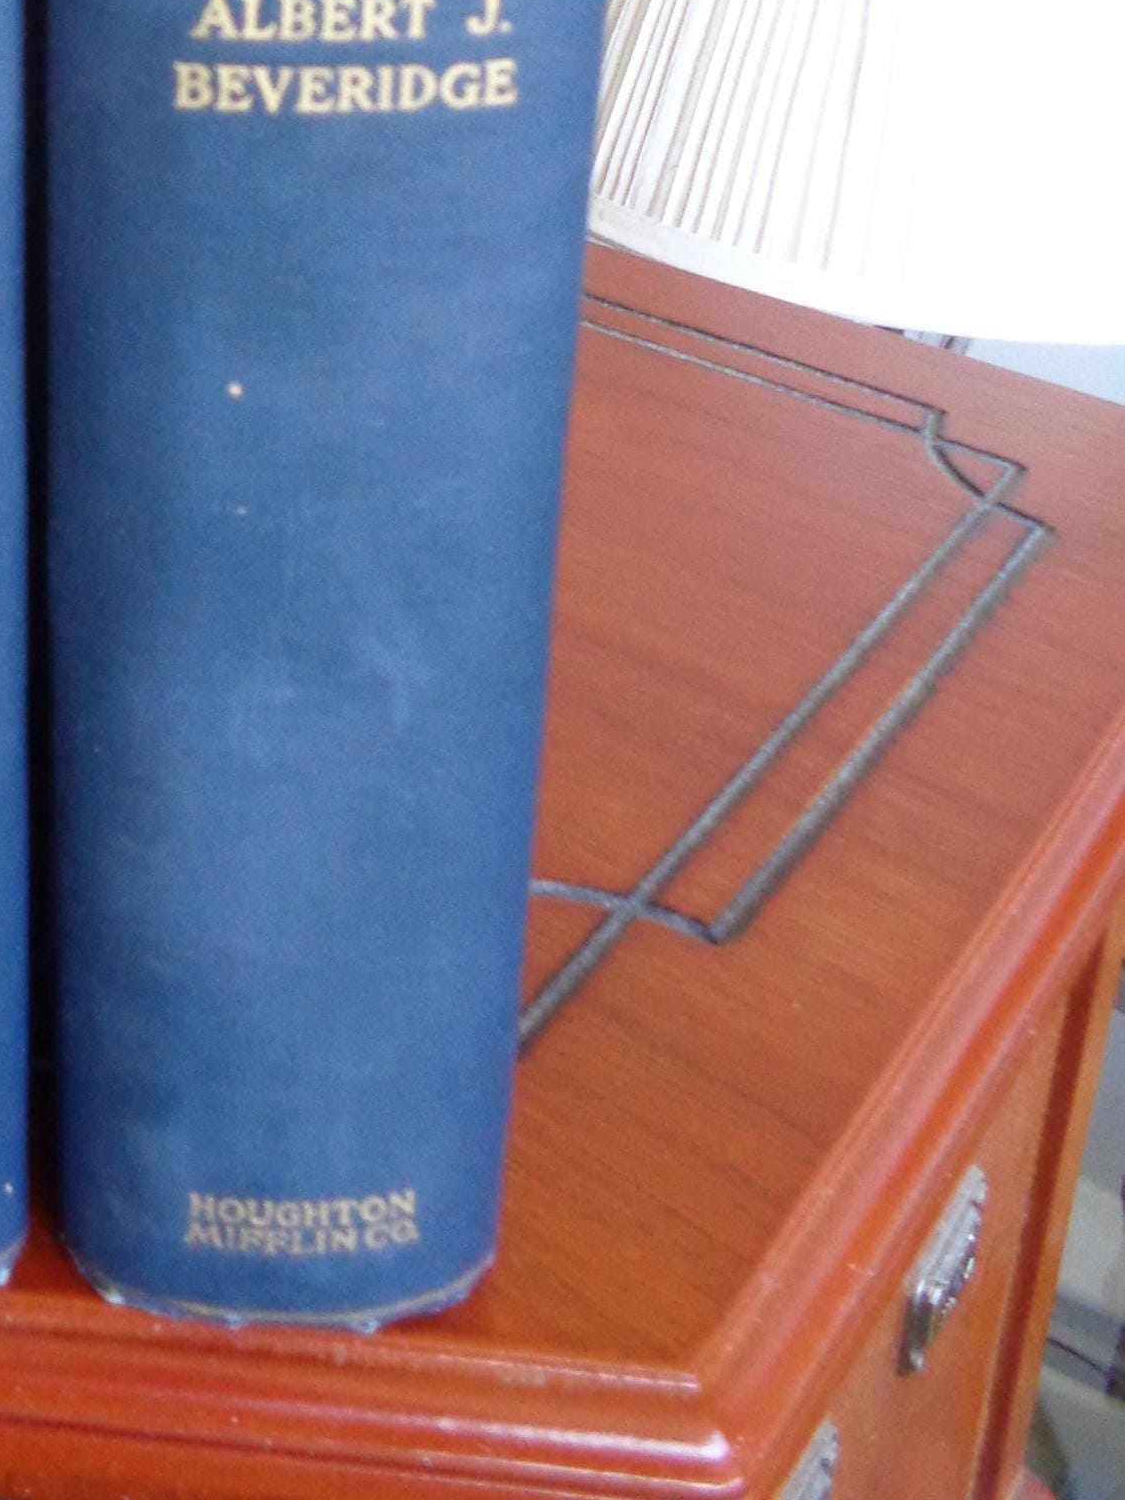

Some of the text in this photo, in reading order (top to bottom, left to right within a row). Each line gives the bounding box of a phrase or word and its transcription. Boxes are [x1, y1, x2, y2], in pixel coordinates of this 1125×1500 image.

[173, 57, 519, 115] BEVERIDGE
[188, 1187, 417, 1227] HOUGHTON
[184, 1220, 358, 1256] MIFFLIN
